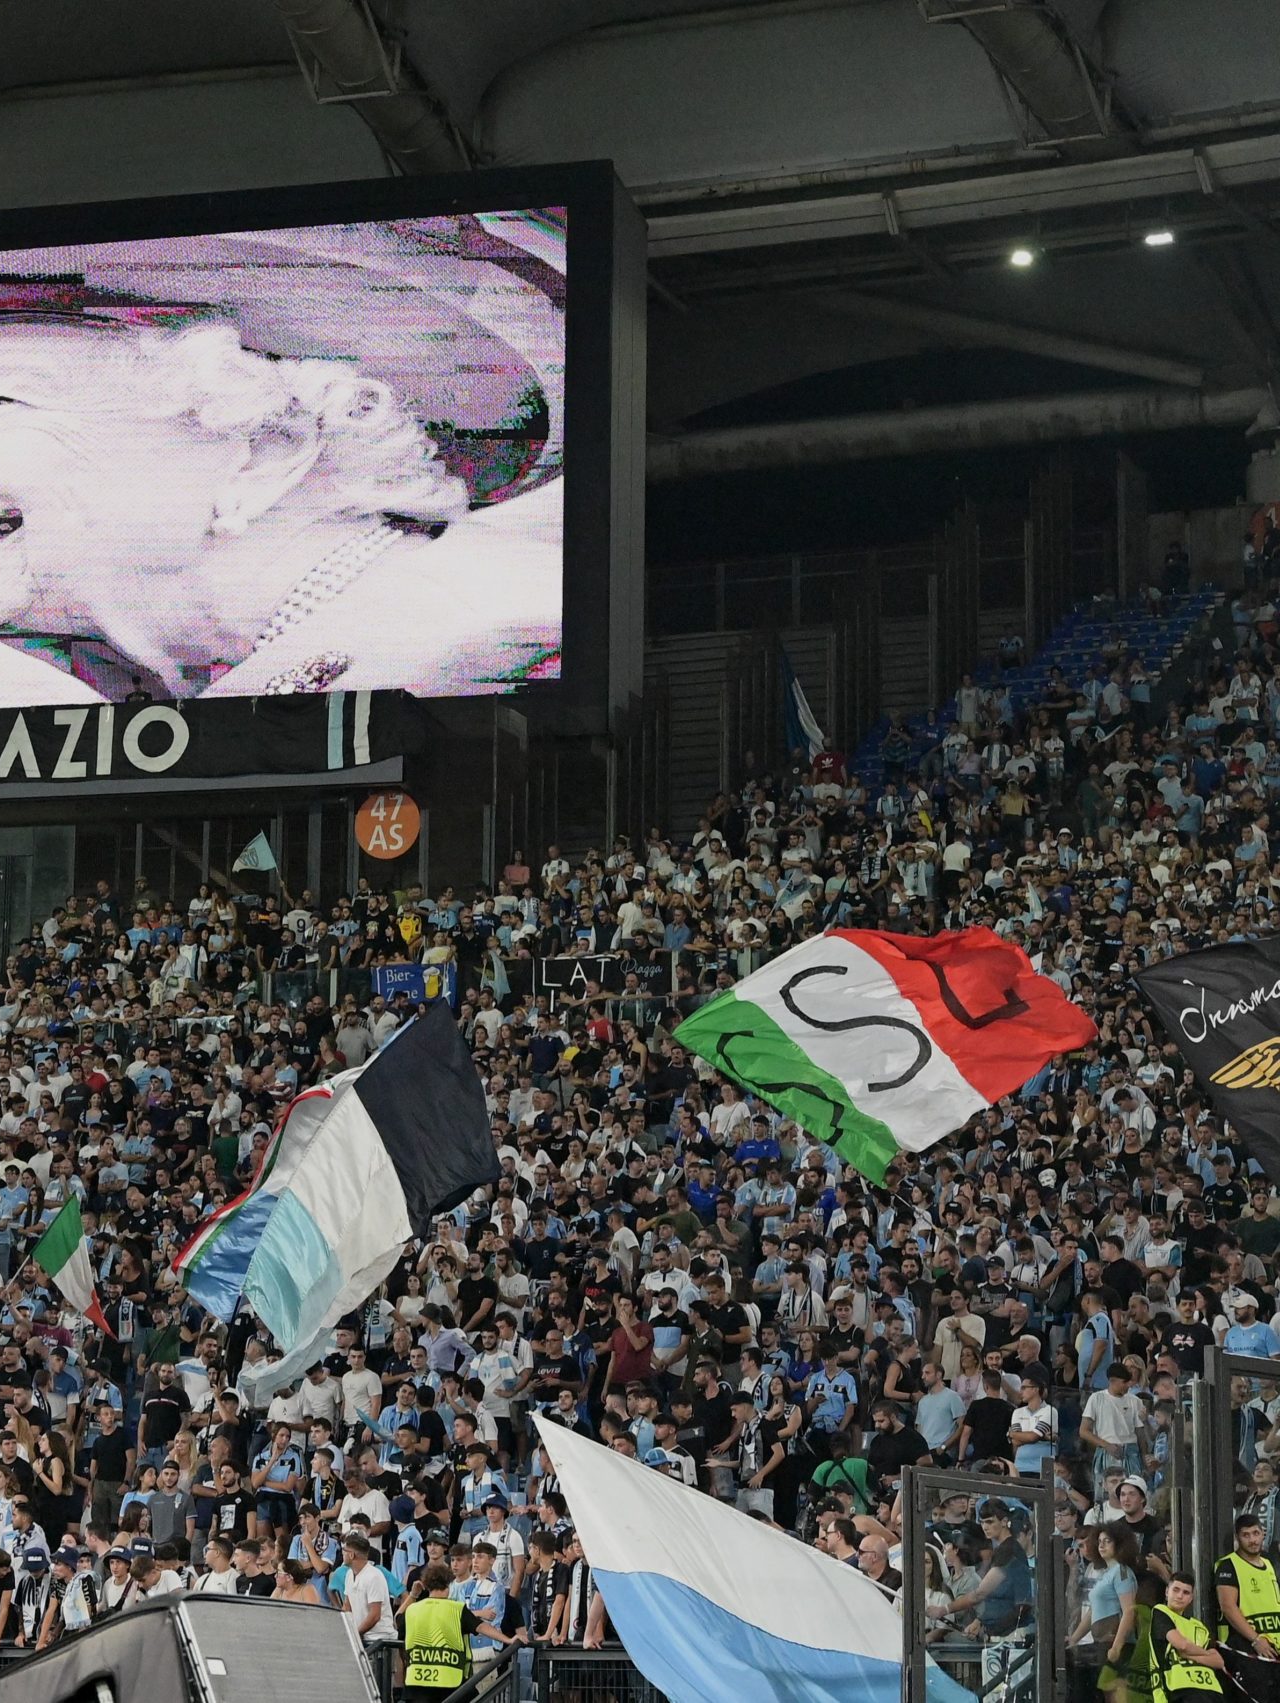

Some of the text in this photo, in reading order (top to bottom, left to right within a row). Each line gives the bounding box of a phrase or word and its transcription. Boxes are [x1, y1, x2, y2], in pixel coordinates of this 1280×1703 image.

[369, 793, 404, 822] 47
[367, 823, 404, 851] AS
[385, 969, 416, 984] Bier-
[386, 987, 419, 1002] Zne
[409, 1647, 460, 1666] EWARD
[414, 1667, 440, 1682] 322
